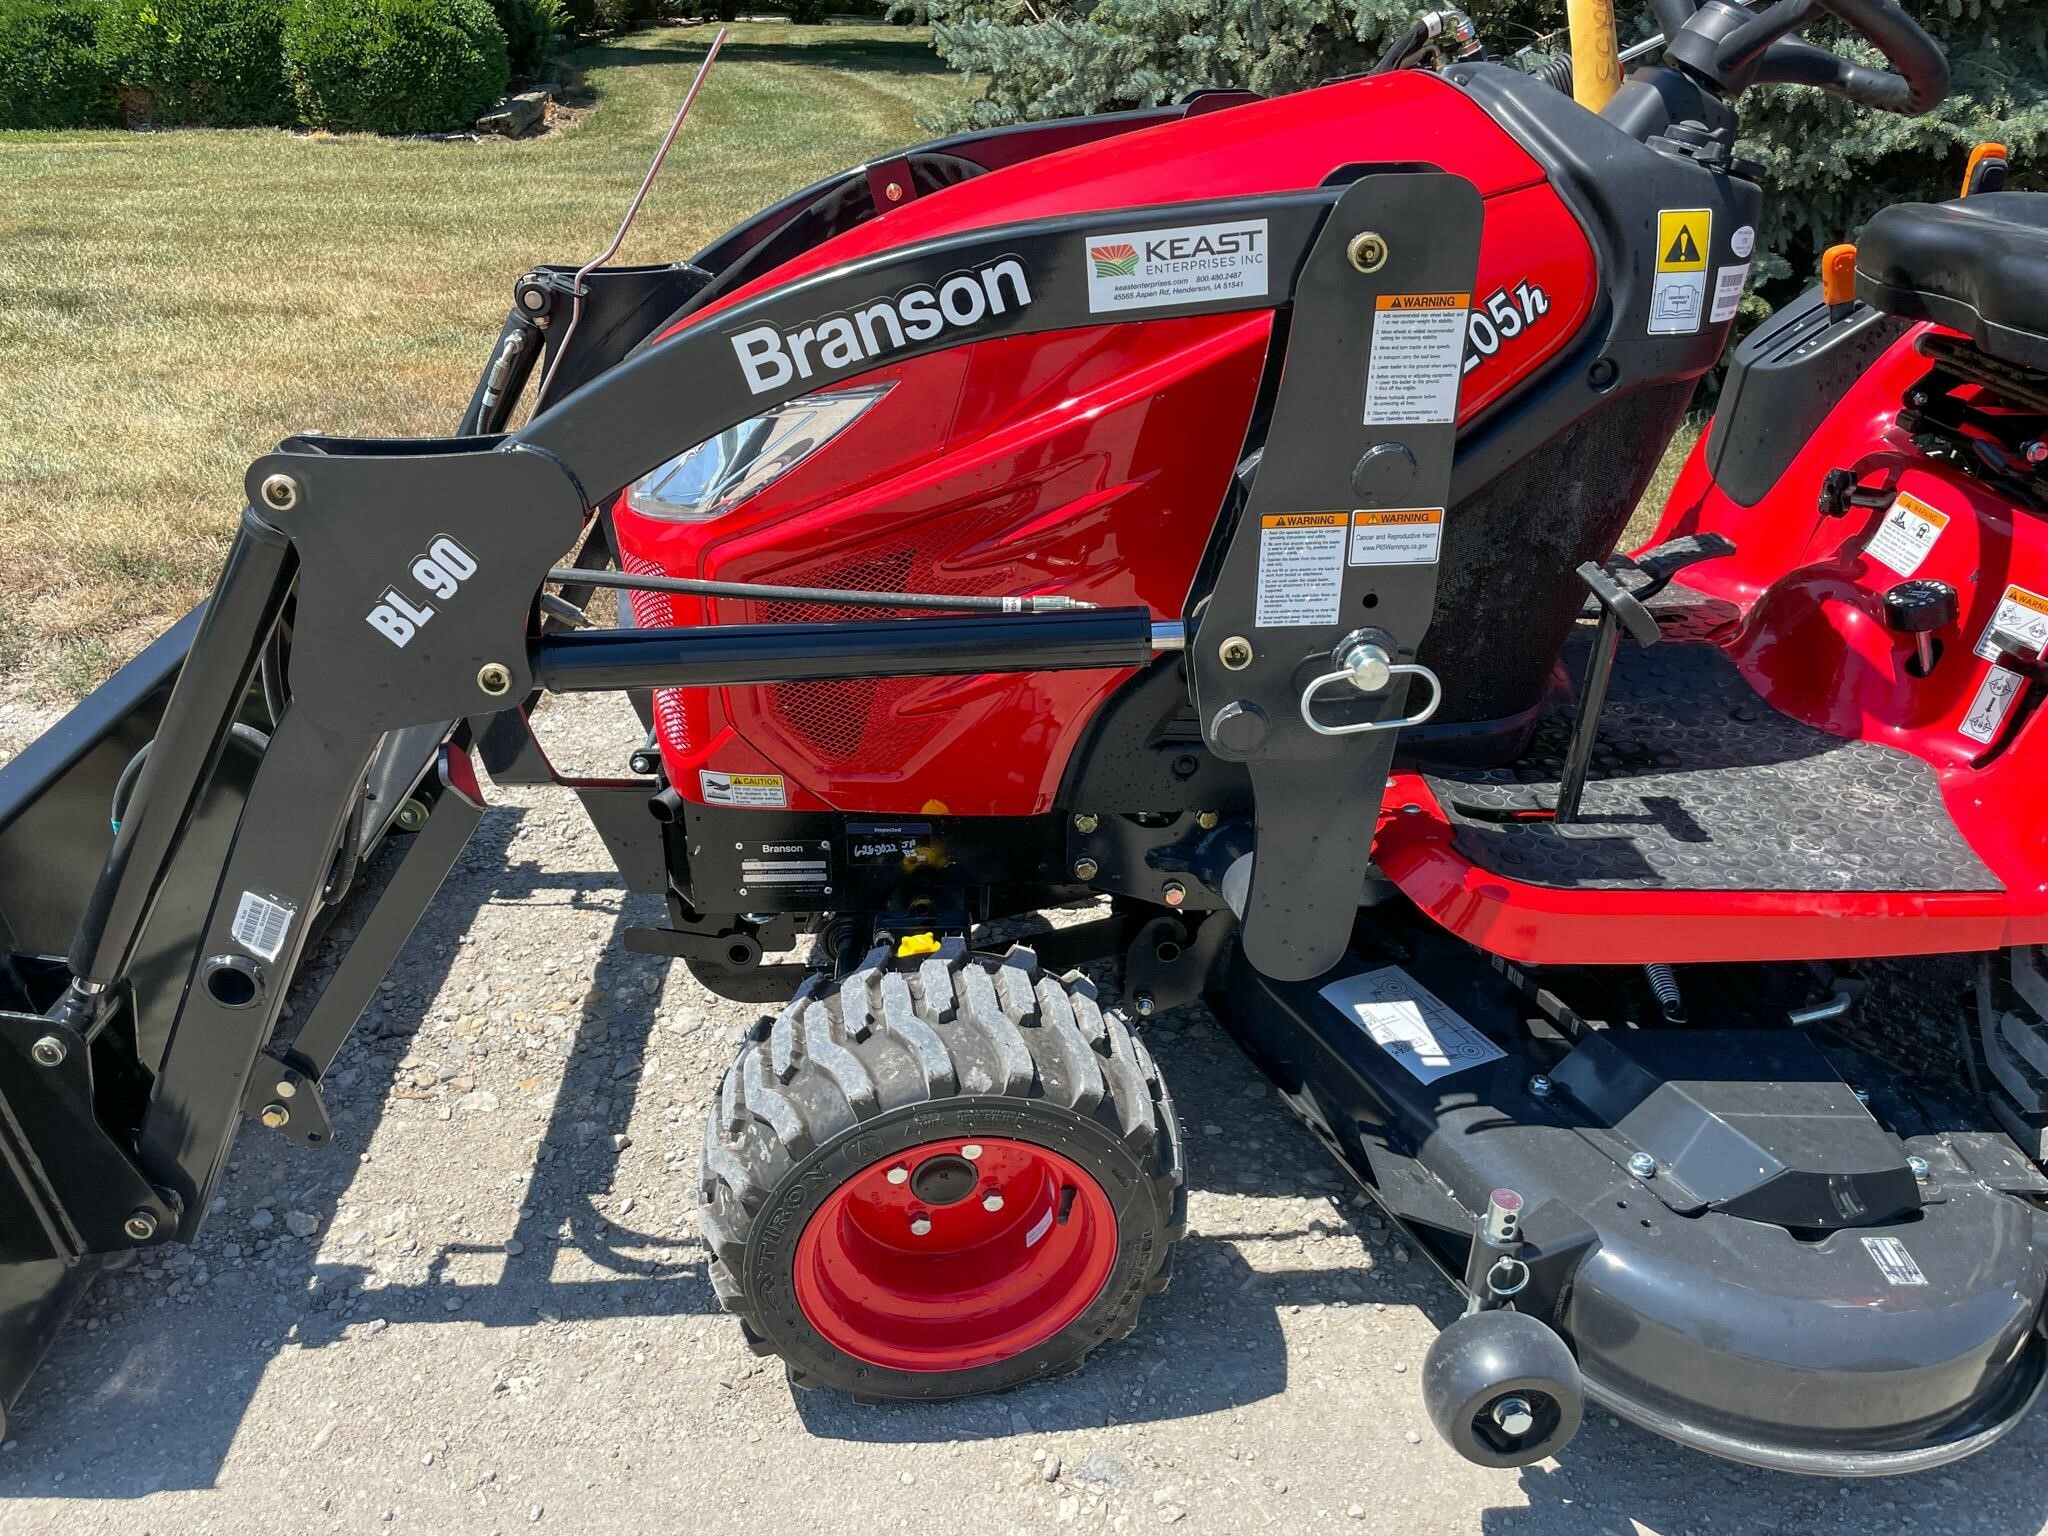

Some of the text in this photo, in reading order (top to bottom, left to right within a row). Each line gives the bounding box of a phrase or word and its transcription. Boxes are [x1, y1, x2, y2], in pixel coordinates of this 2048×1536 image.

[1146, 230, 1262, 262] KEAST
[1146, 254, 1264, 275] ENTERPRISES INC
[1113, 292, 1134, 301] 45565
[1135, 288, 1158, 300] Aspen
[1159, 288, 1171, 296] Rd,
[1172, 285, 1212, 294] Henderson,
[1222, 280, 1244, 290] 51541
[1114, 272, 1242, 291] keastenterprises.com 800.480.2487
[1404, 296, 1455, 308] WARNING
[730, 260, 1032, 395] Branson
[1464, 284, 1548, 374] 05h
[1287, 516, 1335, 526] WARNING
[1381, 513, 1429, 523] WARNING
[1362, 543, 1428, 551] www.P65Warnings.ca.gov
[366, 538, 478, 648] BL 90
[744, 778, 778, 786] CAUTION
[762, 844, 803, 853] Branson
